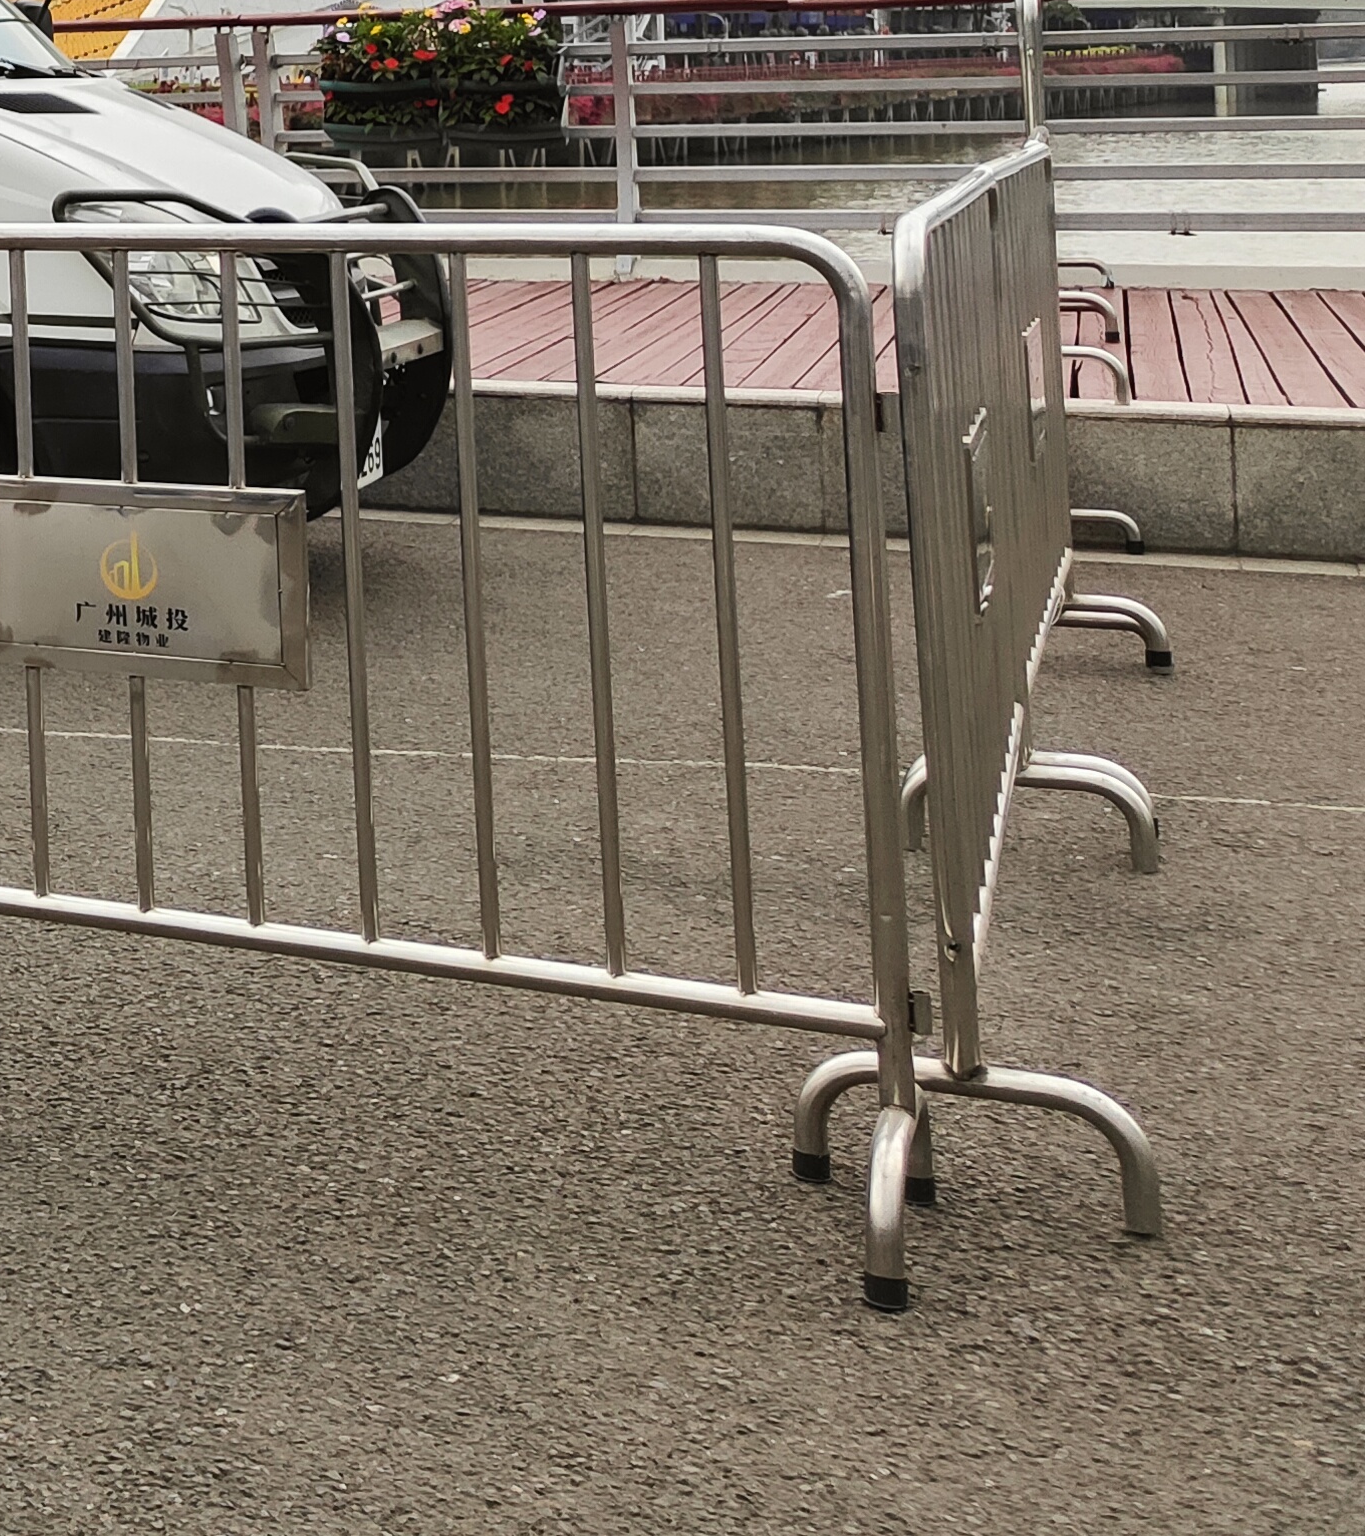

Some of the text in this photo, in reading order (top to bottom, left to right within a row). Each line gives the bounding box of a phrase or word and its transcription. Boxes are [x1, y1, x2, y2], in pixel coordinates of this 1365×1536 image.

[75, 600, 190, 632] 广州城投
[97, 628, 170, 649] 建隆物业
